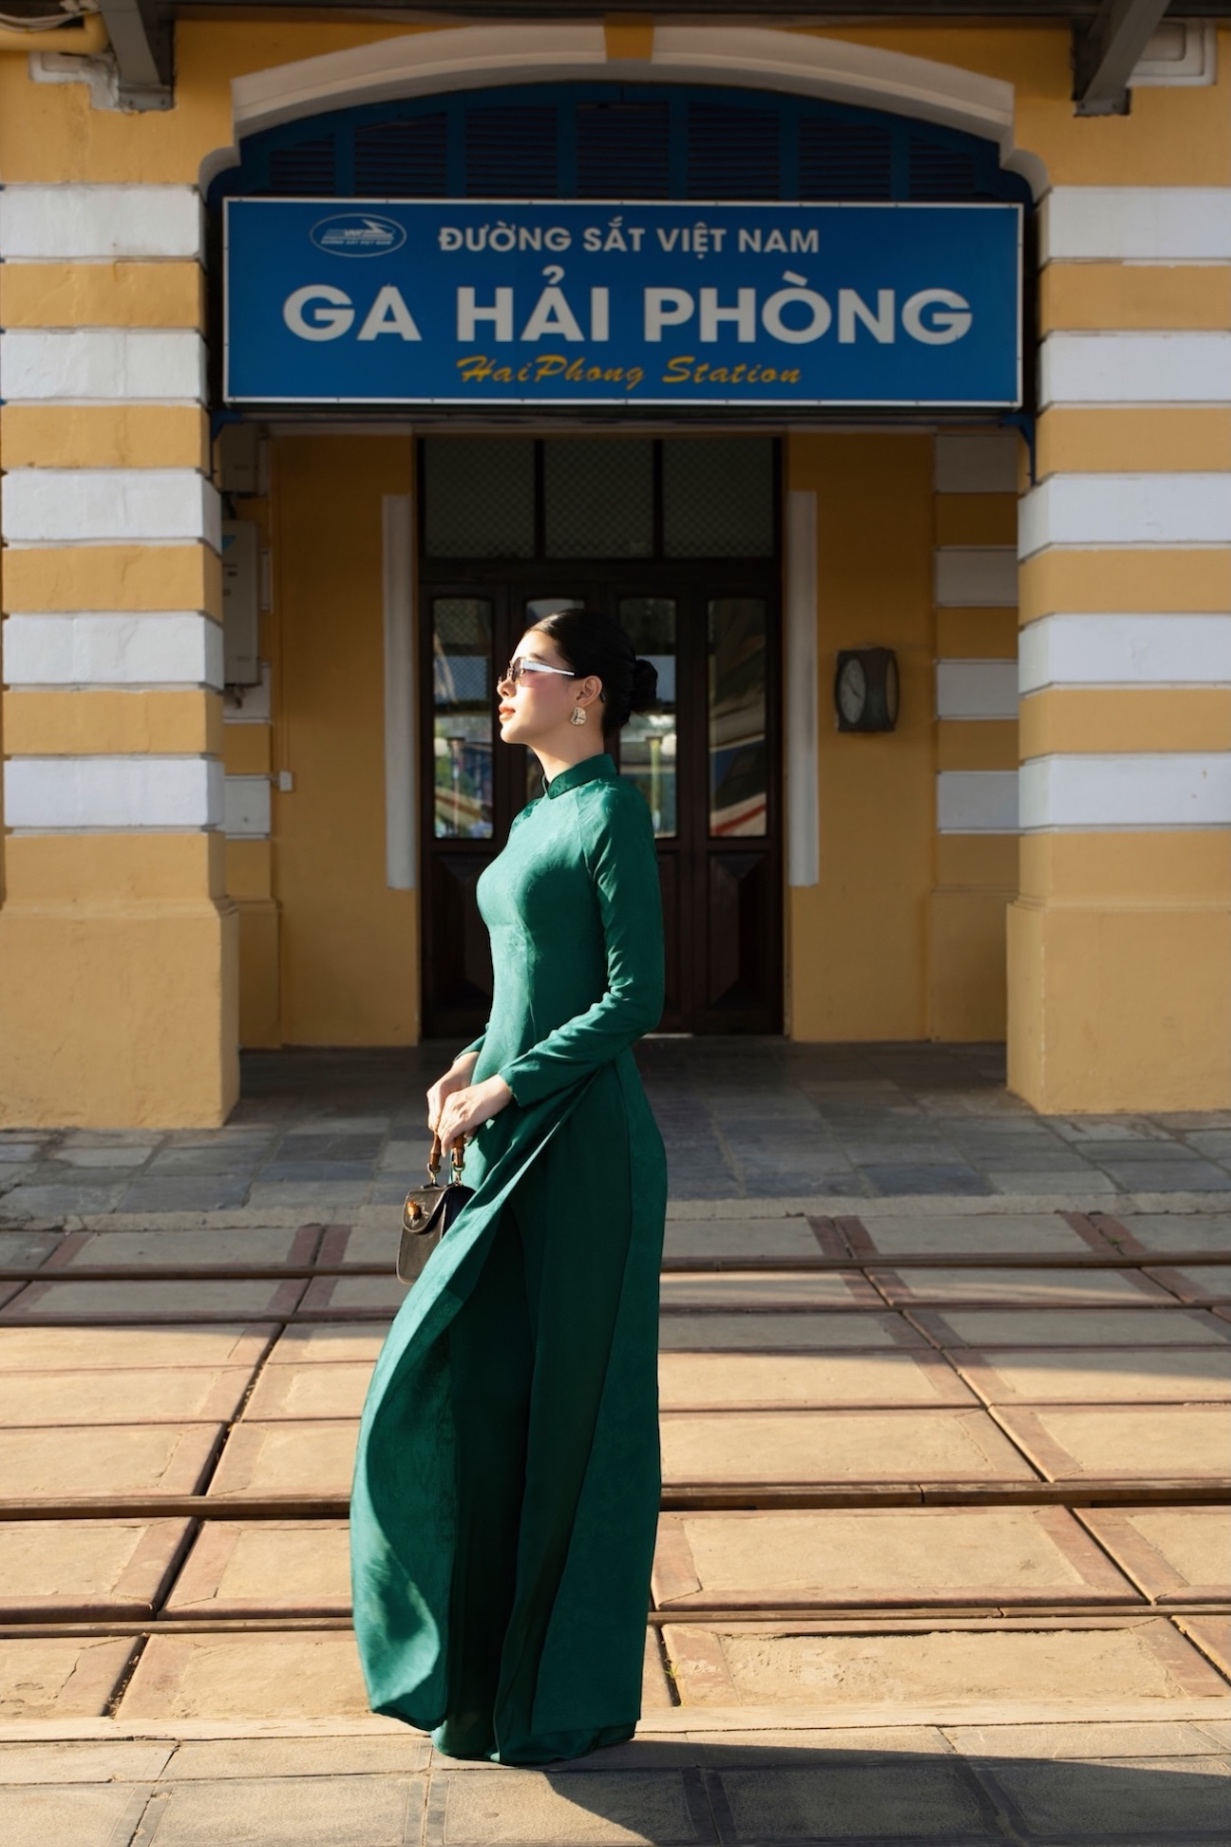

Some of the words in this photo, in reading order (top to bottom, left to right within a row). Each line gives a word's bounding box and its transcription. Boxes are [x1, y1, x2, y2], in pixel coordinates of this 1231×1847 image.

[438, 221, 571, 252] ĐƯỜNG
[584, 215, 645, 252] SẮT
[657, 222, 726, 259] VIỆT
[739, 229, 819, 253] NAM
[283, 284, 422, 342] GA
[457, 265, 609, 342] HẢI
[644, 270, 973, 345] PHÒNG
[456, 354, 645, 390] HaiPhong
[662, 355, 801, 384] Station
